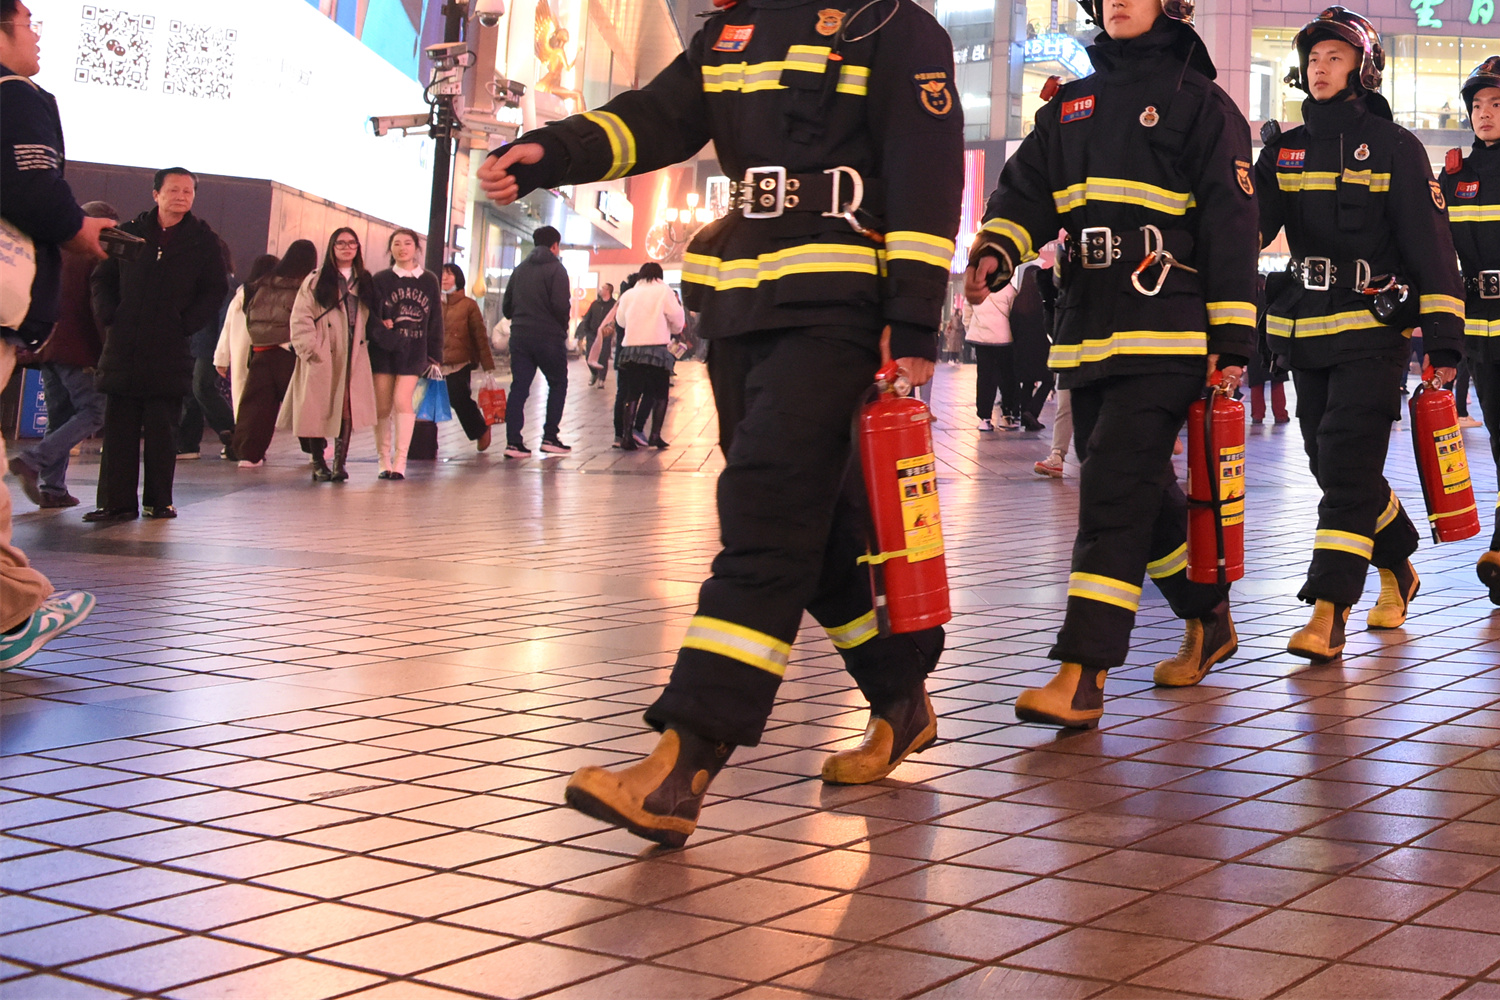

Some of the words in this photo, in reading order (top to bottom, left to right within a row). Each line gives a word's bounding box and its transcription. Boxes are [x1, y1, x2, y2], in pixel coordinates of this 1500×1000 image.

[1073, 99, 1093, 112] 119
[1290, 151, 1306, 160] 119
[1466, 183, 1478, 192] 119
